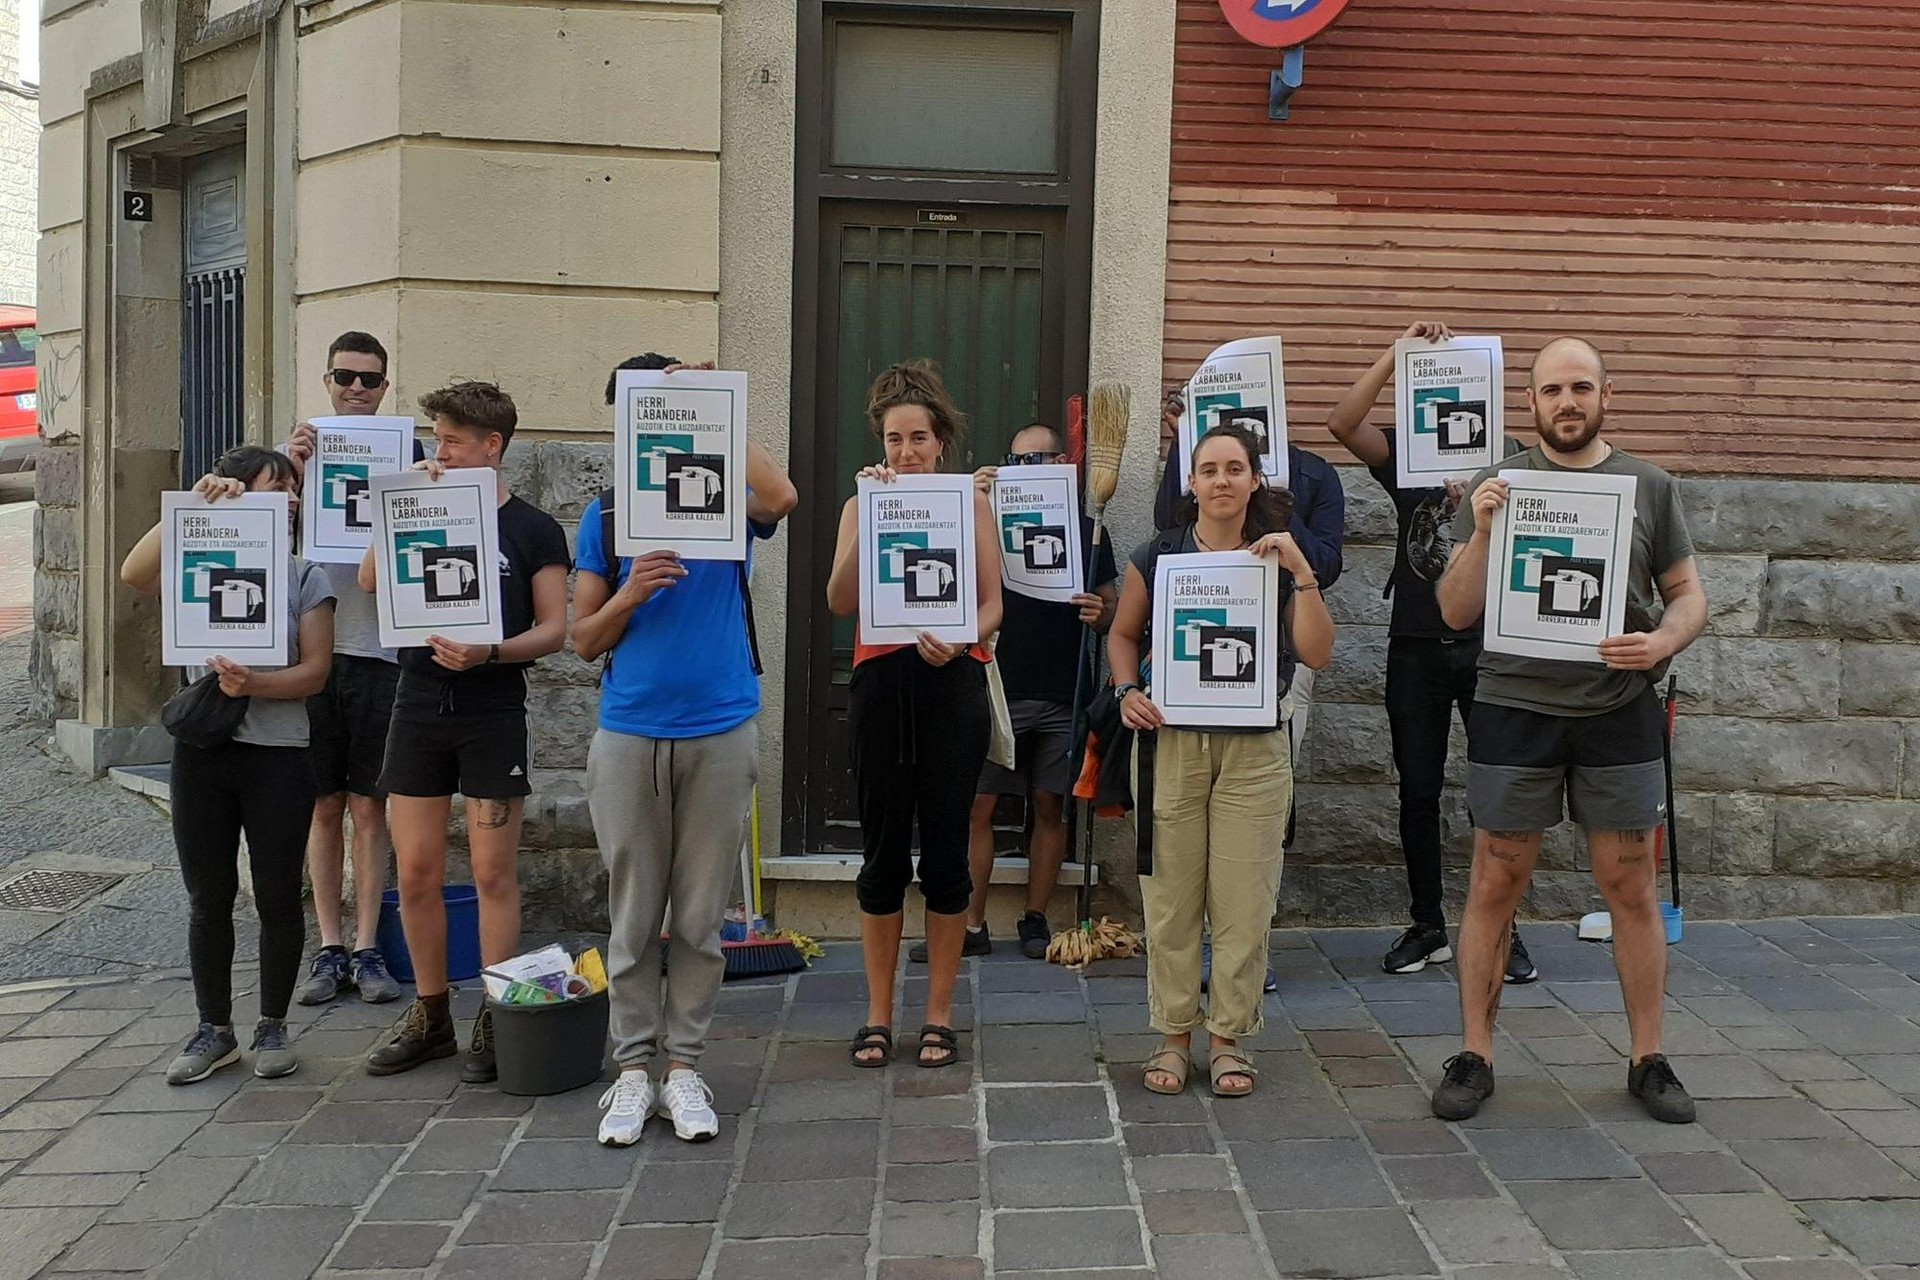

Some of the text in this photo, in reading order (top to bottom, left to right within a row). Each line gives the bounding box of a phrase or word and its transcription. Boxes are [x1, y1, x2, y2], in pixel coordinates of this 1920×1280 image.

[131, 196, 144, 216] 2
[929, 212, 957, 221] Entrada
[1413, 358, 1436, 368] HERRI
[1198, 365, 1216, 374] ERRI
[1413, 366, 1462, 378] LABANDERIA
[1194, 372, 1242, 385] LABANDERIA
[636, 396, 666, 408] HERRI
[637, 408, 697, 421] LABANDERIA
[636, 422, 726, 433] AUZOTIK ETA AUZOARENTZAT
[323, 434, 346, 444] HERRI
[323, 444, 372, 454] LABANDERIA
[1001, 486, 1022, 495] HERRI
[391, 497, 419, 508] HERRI
[877, 499, 903, 510] HERRI
[1001, 494, 1044, 504] LABANDERIA
[1516, 498, 1547, 510] HERRI
[392, 507, 448, 520] LABANDERIA
[695, 513, 714, 521] KALEA
[878, 510, 931, 521] LABANDERIA
[1515, 510, 1579, 524] LABANDERIA
[183, 517, 210, 527] HERRI
[393, 520, 419, 529] AUZOTIK
[420, 519, 430, 528] ETA
[877, 522, 901, 530] AUZOTIK
[914, 521, 957, 529] AUZOARENTZAT
[183, 528, 240, 539] LABANDERIA
[1514, 523, 1610, 537] AUZOTIK ETA AUZOARENTZAT
[1175, 575, 1201, 586] HERRI
[1174, 585, 1230, 596] LABANDERIA
[1200, 598, 1211, 606] ETA
[1212, 598, 1258, 606] AUZOARENTZAT
[1537, 615, 1600, 627] KORRERIA KALEA 117
